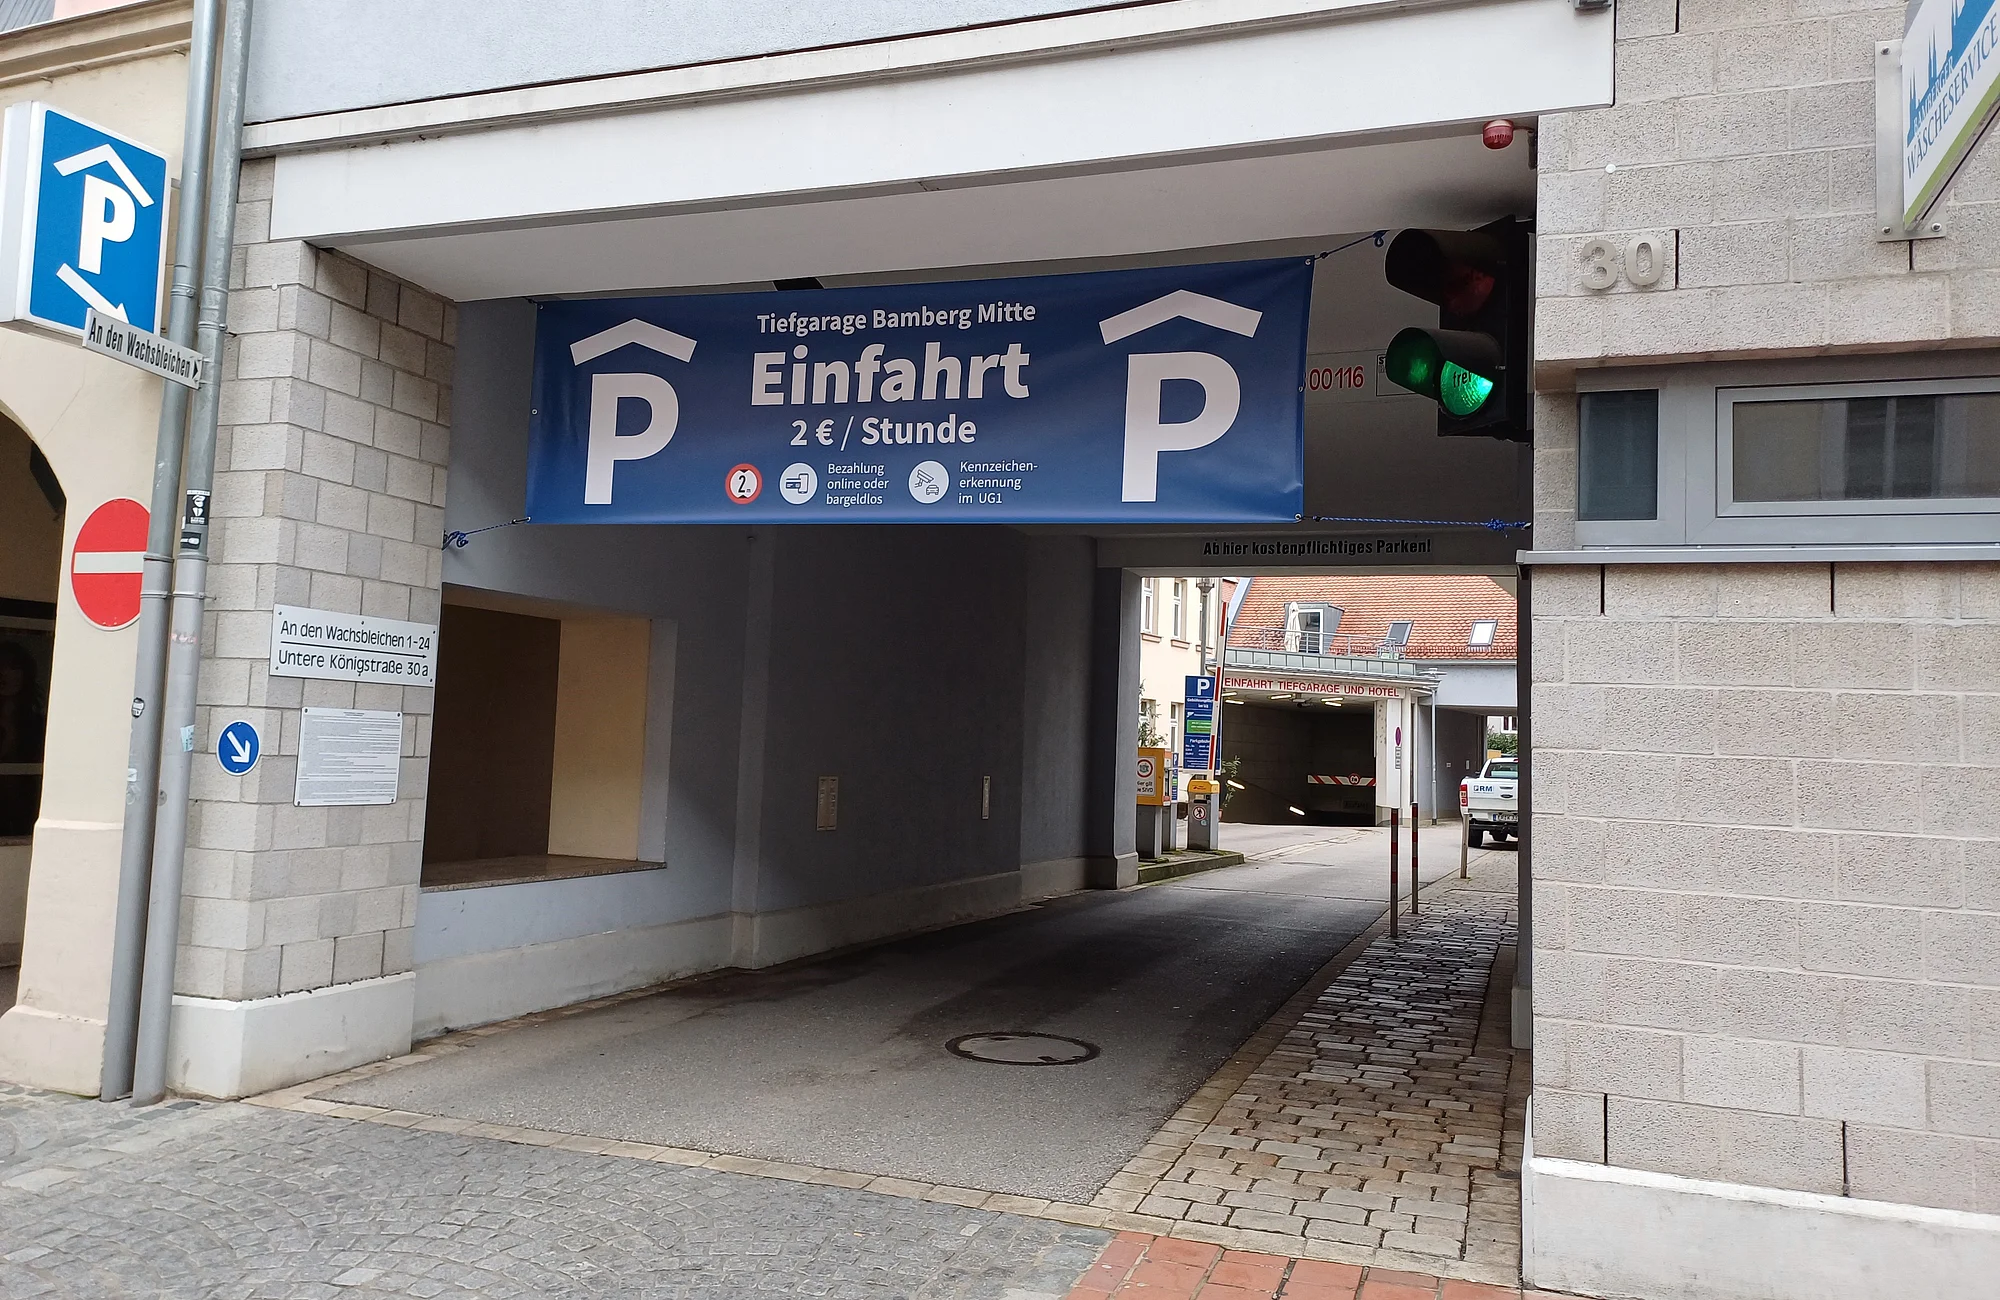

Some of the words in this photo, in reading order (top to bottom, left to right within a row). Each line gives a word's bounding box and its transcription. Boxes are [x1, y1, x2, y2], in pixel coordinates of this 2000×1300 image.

[1906, 12, 1999, 179] WÄSCHESERVICE
[1913, 55, 1954, 134] BAMBERGER
[78, 174, 136, 274] P
[1581, 235, 1664, 290] 30
[757, 312, 867, 337] Tiefgarage
[872, 305, 972, 330] Bamberg
[977, 301, 1036, 323] Mitte
[88, 317, 103, 345] An
[105, 324, 123, 352] den
[126, 331, 191, 378] Wachsbleichen
[751, 341, 1030, 406] Einfahrt
[1304, 366, 1364, 391] 00116
[1453, 371, 1471, 388] frei
[584, 373, 679, 505] P
[789, 419, 808, 446] 2
[815, 418, 835, 446] €
[839, 416, 854, 451] /
[861, 413, 976, 445] Stunde
[1120, 351, 1242, 503] P
[827, 463, 885, 477] Bezahlung
[960, 460, 1038, 473] Kennzeichen-
[827, 478, 861, 490] online
[863, 477, 889, 490] oder
[959, 476, 1022, 491] erkennung
[826, 492, 883, 508] bargeldlos
[958, 493, 973, 504] im
[978, 491, 1003, 504] UG1
[1203, 540, 1220, 555] Ab
[1222, 541, 1249, 555] hier
[1252, 540, 1373, 557] kostenpflichtiges
[1376, 538, 1431, 554] Parken!
[280, 620, 297, 636] An
[300, 622, 323, 639] den
[325, 625, 405, 648] Wachsbleichen
[406, 635, 430, 650] 1-24
[278, 649, 325, 667] Untere
[329, 654, 403, 674] Königstraße
[1197, 678, 1210, 696] P
[1224, 677, 1274, 690] EINFAHRT
[1277, 680, 1340, 694] TIEFGARAGE
[1343, 685, 1365, 695] UND
[1368, 687, 1400, 697] HOTEL
